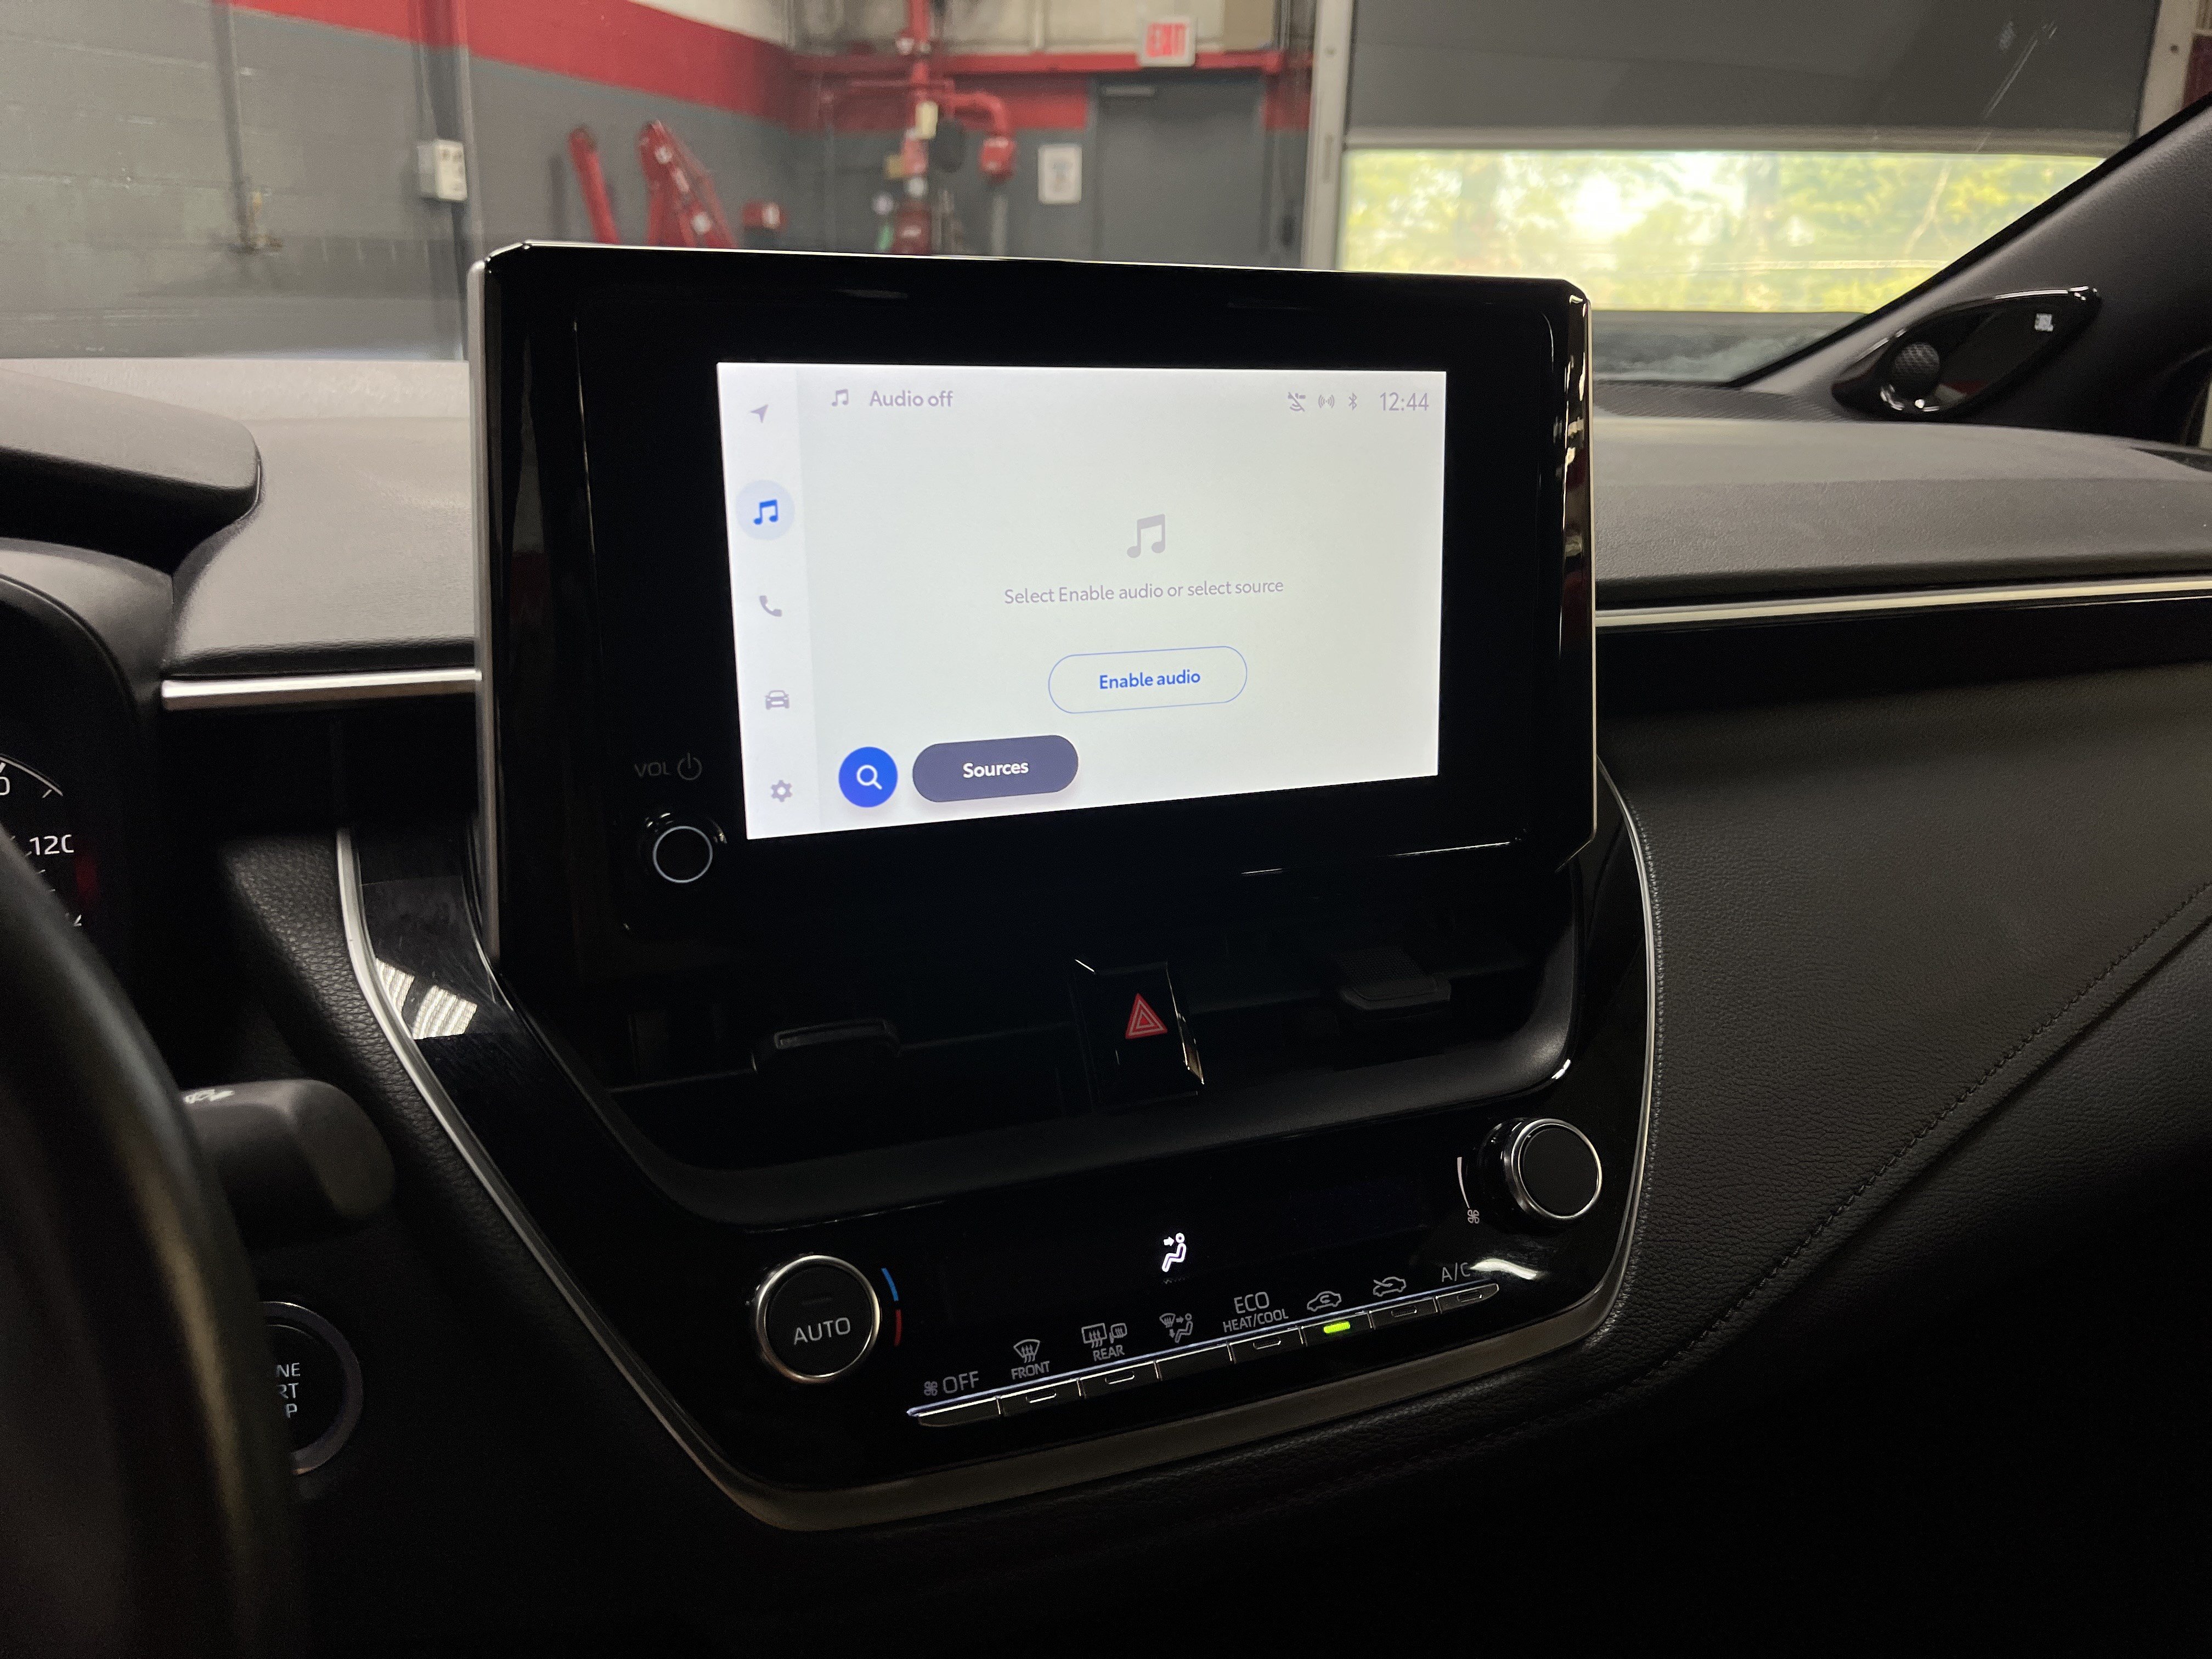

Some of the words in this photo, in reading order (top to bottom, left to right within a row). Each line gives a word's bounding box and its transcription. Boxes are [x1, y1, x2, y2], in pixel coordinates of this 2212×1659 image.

[869, 390, 924, 407] Audio
[927, 390, 953, 407] off
[1380, 392, 1430, 411] 12:44
[1005, 586, 1056, 604] Select
[1059, 584, 1115, 602] Enable
[1119, 583, 1164, 600] audio
[1167, 586, 1184, 597] or
[1187, 580, 1233, 597] select
[1235, 581, 1284, 594] source
[1099, 672, 1154, 690] Enable
[1156, 669, 1201, 686] audio
[634, 761, 672, 777] VOL
[963, 761, 1029, 778] Sources
[1441, 1261, 1471, 1283] A/C
[1233, 1291, 1270, 1314] ECO
[1222, 1308, 1289, 1333] HEAT/COOL
[793, 1317, 851, 1346] AUTO
[1092, 1344, 1125, 1362] REAR
[1011, 1360, 1050, 1380] FRONT
[942, 1370, 979, 1394] OFF
